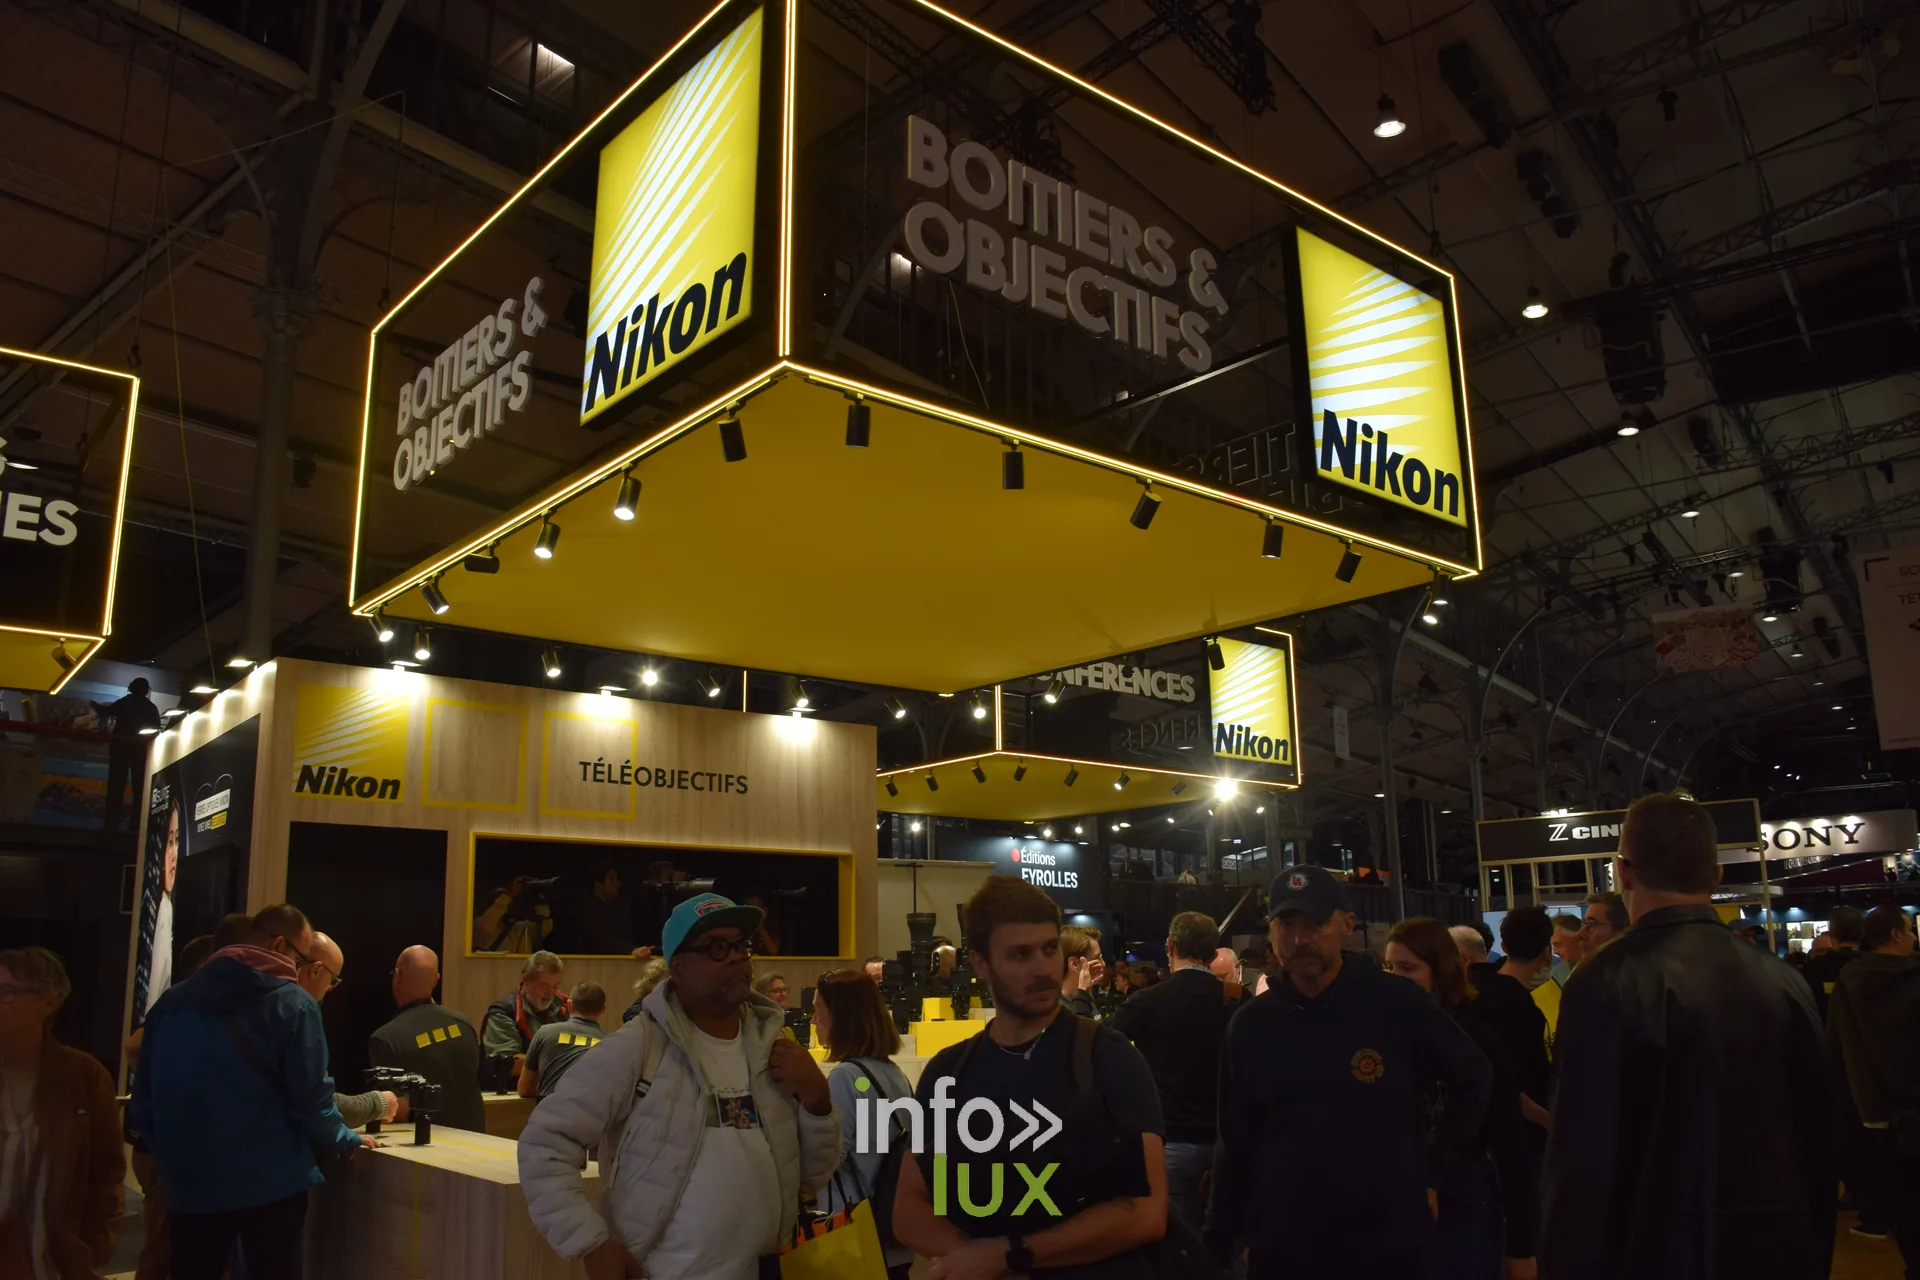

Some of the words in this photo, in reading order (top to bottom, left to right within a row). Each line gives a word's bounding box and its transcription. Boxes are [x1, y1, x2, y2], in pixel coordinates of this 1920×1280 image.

[907, 114, 1177, 288] BOITIERS
[1188, 248, 1229, 316] &
[904, 201, 1213, 373] OBJECTIFS
[396, 298, 517, 436] BOITIERS
[521, 276, 548, 338] &
[584, 252, 747, 413] Nikon
[393, 350, 534, 492] OBJECTIFS
[1320, 408, 1459, 517] Nikon
[0, 491, 80, 546] ES
[1216, 722, 1289, 762] Nikon
[295, 764, 401, 800] Nikon
[578, 756, 748, 794] TÉLÉOBJECTIFS
[1020, 846, 1056, 866] Éditions
[1572, 824, 1624, 839] CIN
[1021, 867, 1079, 889] EYROLLES
